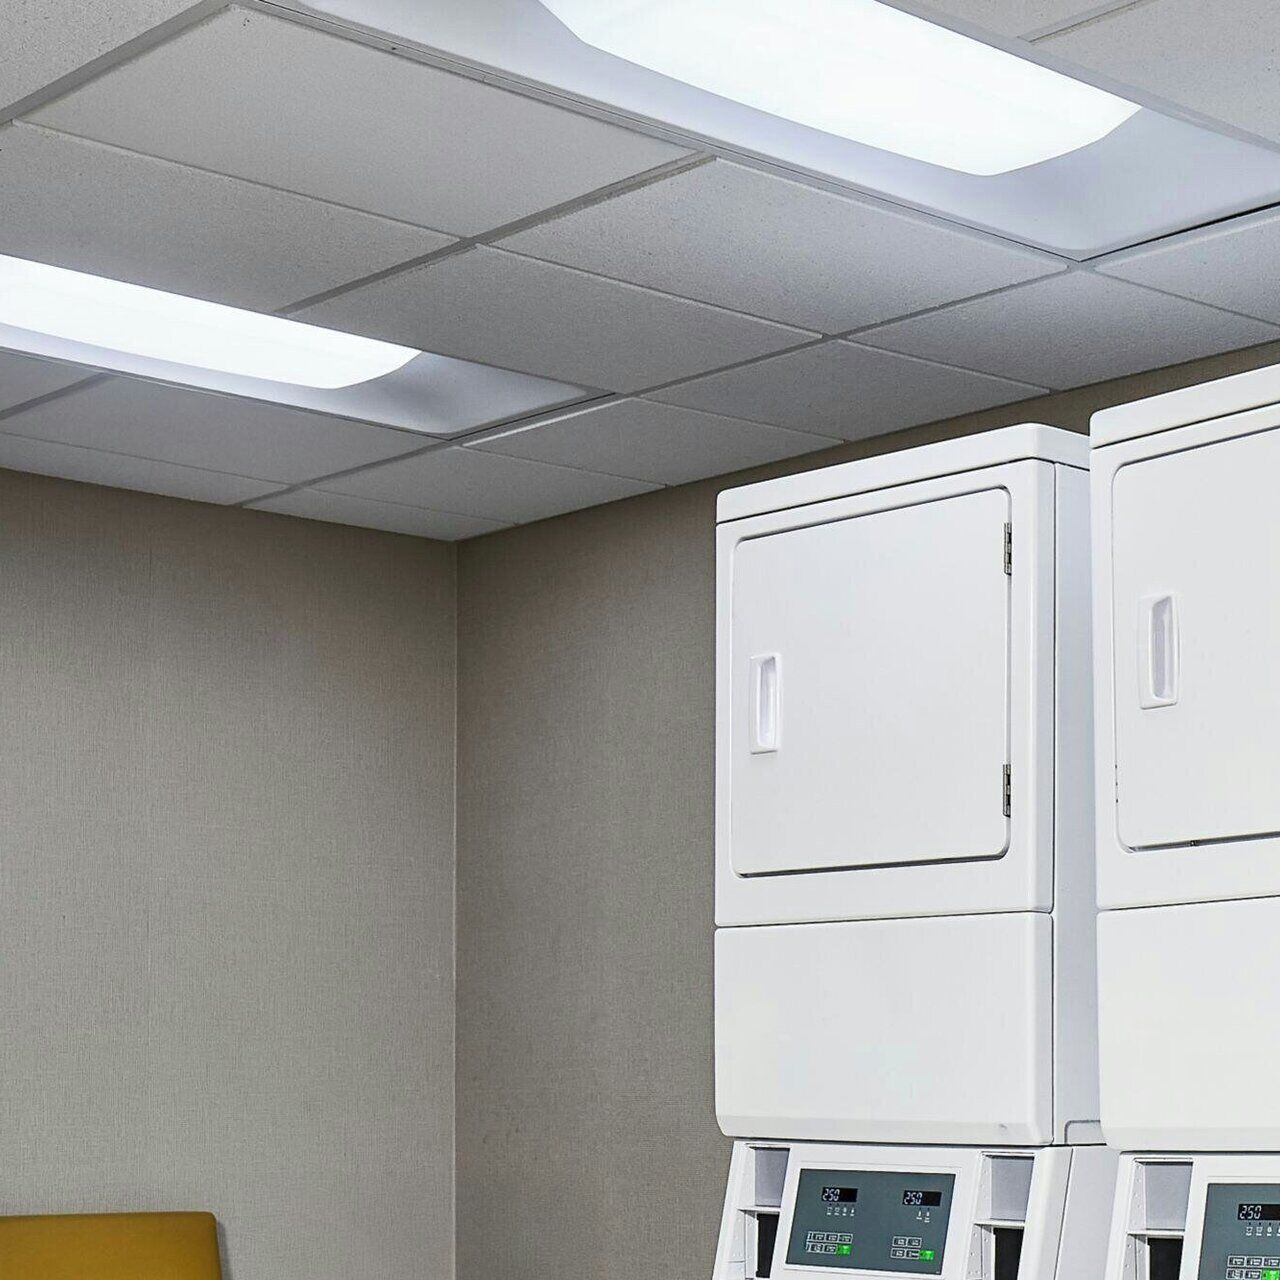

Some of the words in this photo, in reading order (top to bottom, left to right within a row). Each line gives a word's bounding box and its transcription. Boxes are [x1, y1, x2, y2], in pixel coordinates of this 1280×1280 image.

[823, 1189, 840, 1201] 250
[904, 1192, 923, 1205] 250
[1240, 1205, 1262, 1219] 250
